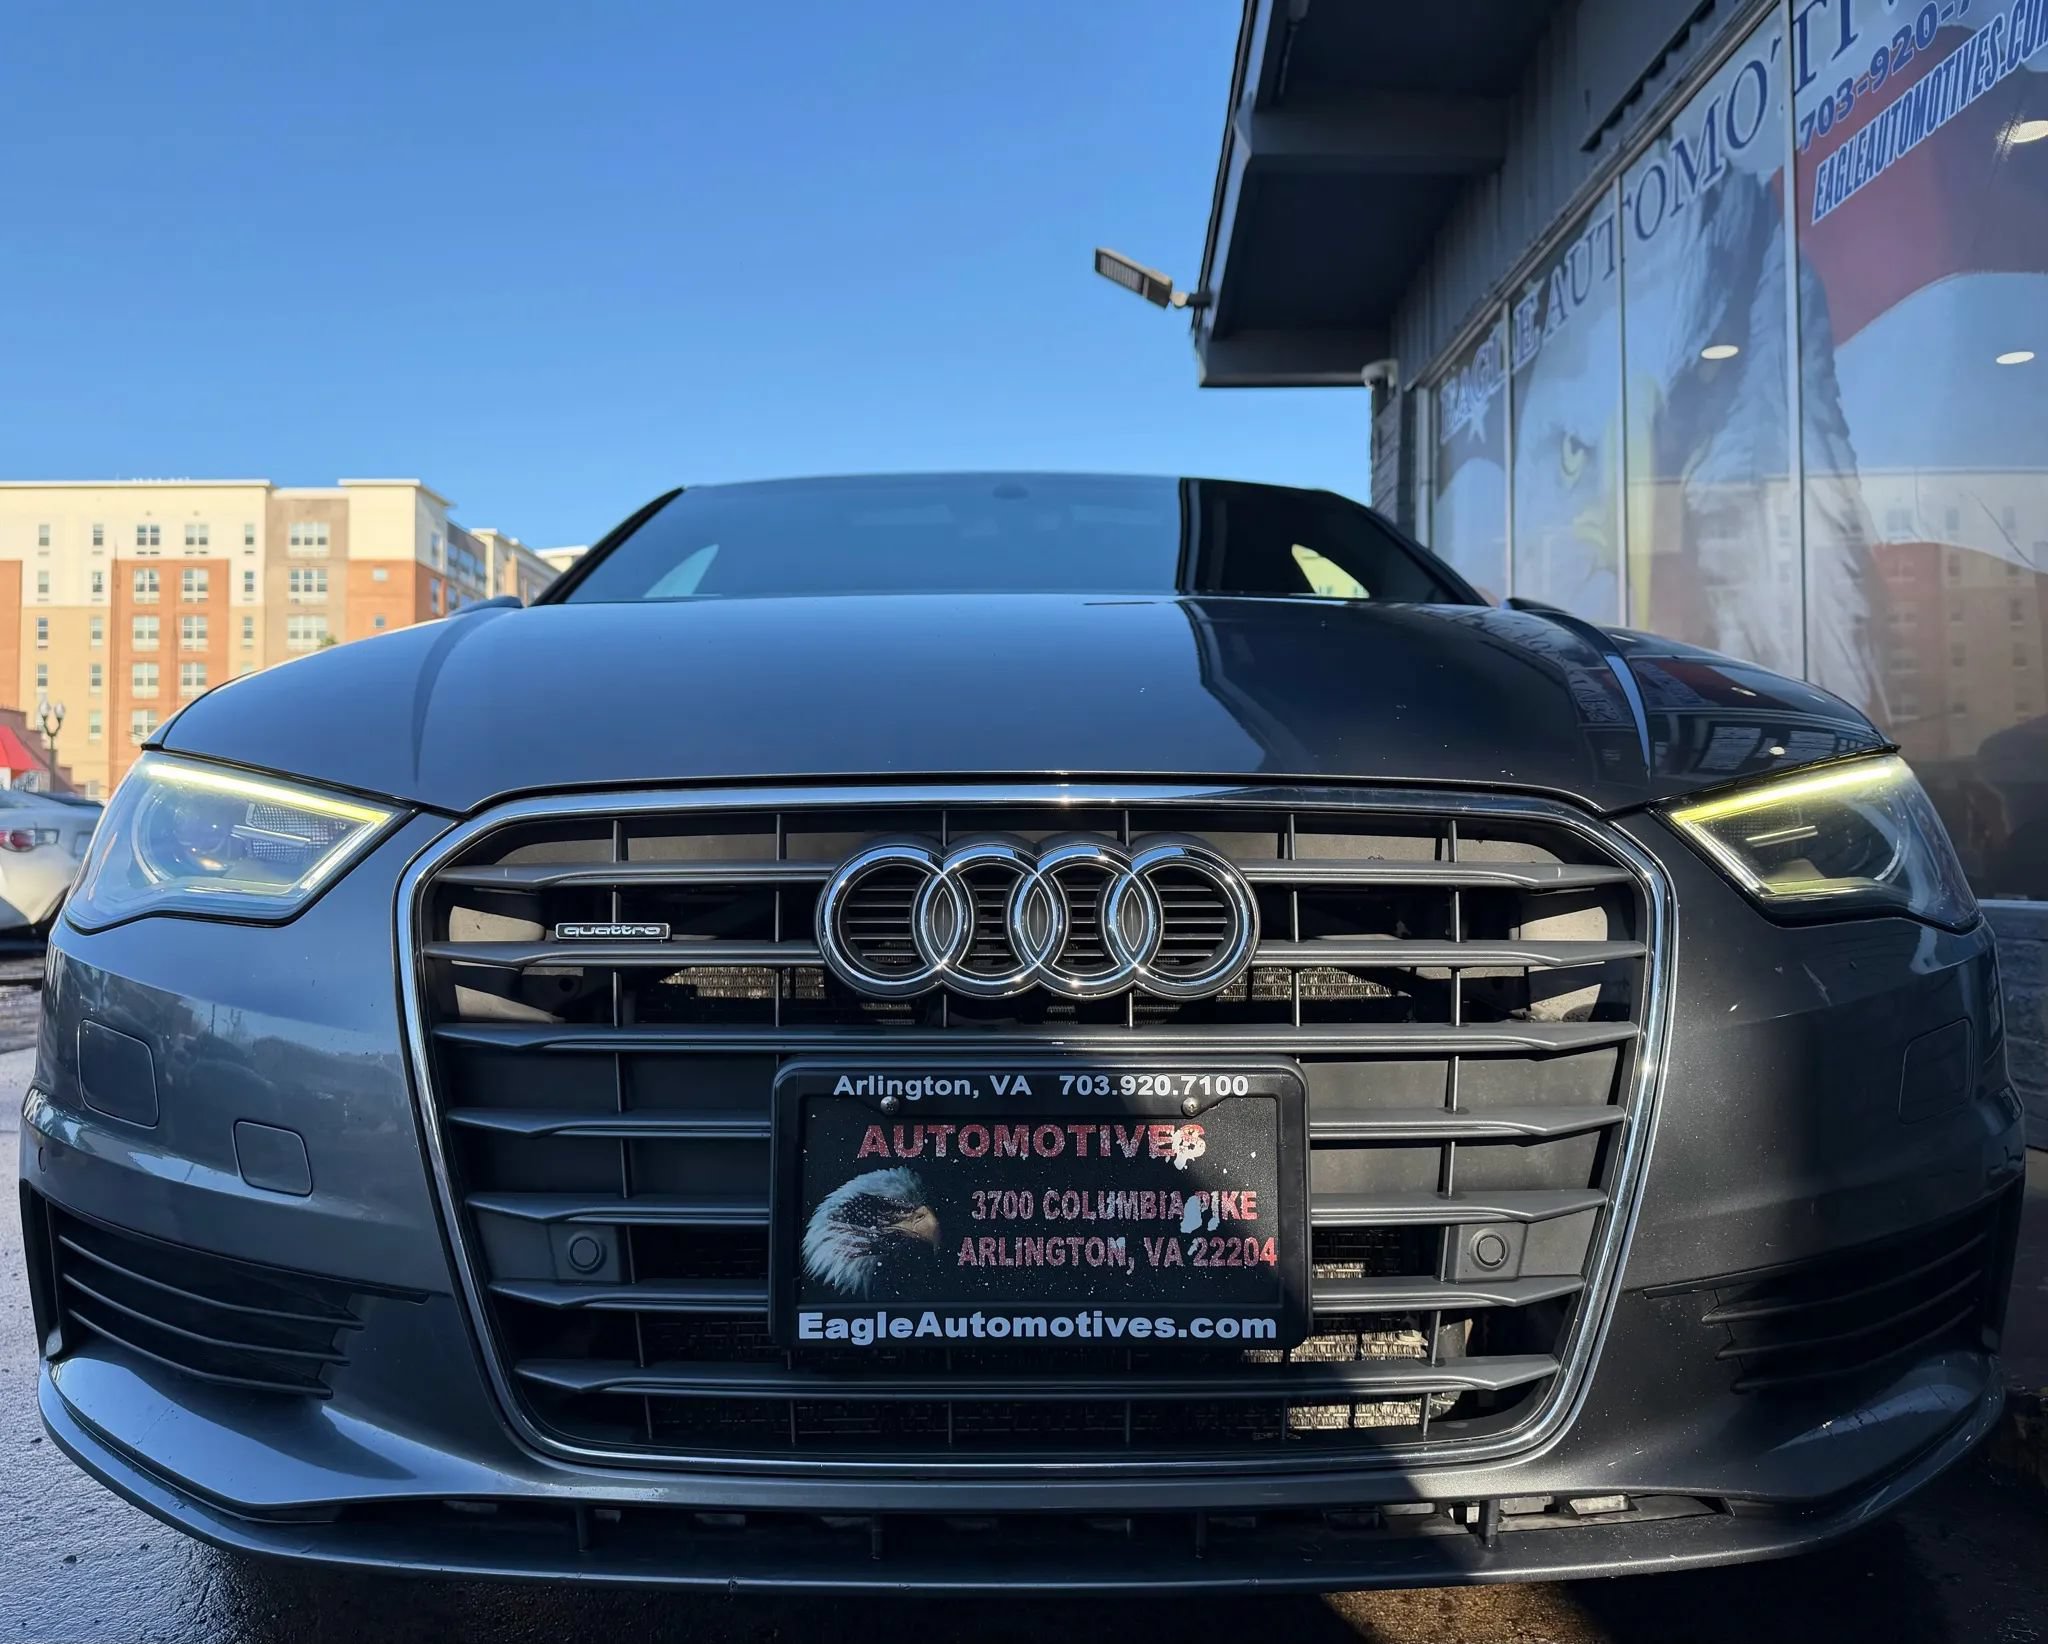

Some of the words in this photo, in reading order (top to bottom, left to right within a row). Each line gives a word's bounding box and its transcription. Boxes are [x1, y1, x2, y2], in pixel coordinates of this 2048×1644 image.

[1543, 0, 1898, 338] AUTOMOTI
[563, 924, 661, 937] quattro
[833, 1075, 980, 1100] Arlington,
[989, 1075, 1033, 1096] VA
[1059, 1075, 1249, 1096] 703.920.7100
[856, 1123, 1207, 1160] AUTOMOTIVES
[971, 1190, 1034, 1220] 3700
[1042, 1190, 1184, 1221] COLUMBIA
[957, 1236, 1135, 1275] ARLINGTON,
[1143, 1236, 1184, 1267] VA
[1192, 1236, 1278, 1267] 22204
[798, 1311, 1277, 1346] EagleAutomotives.com
